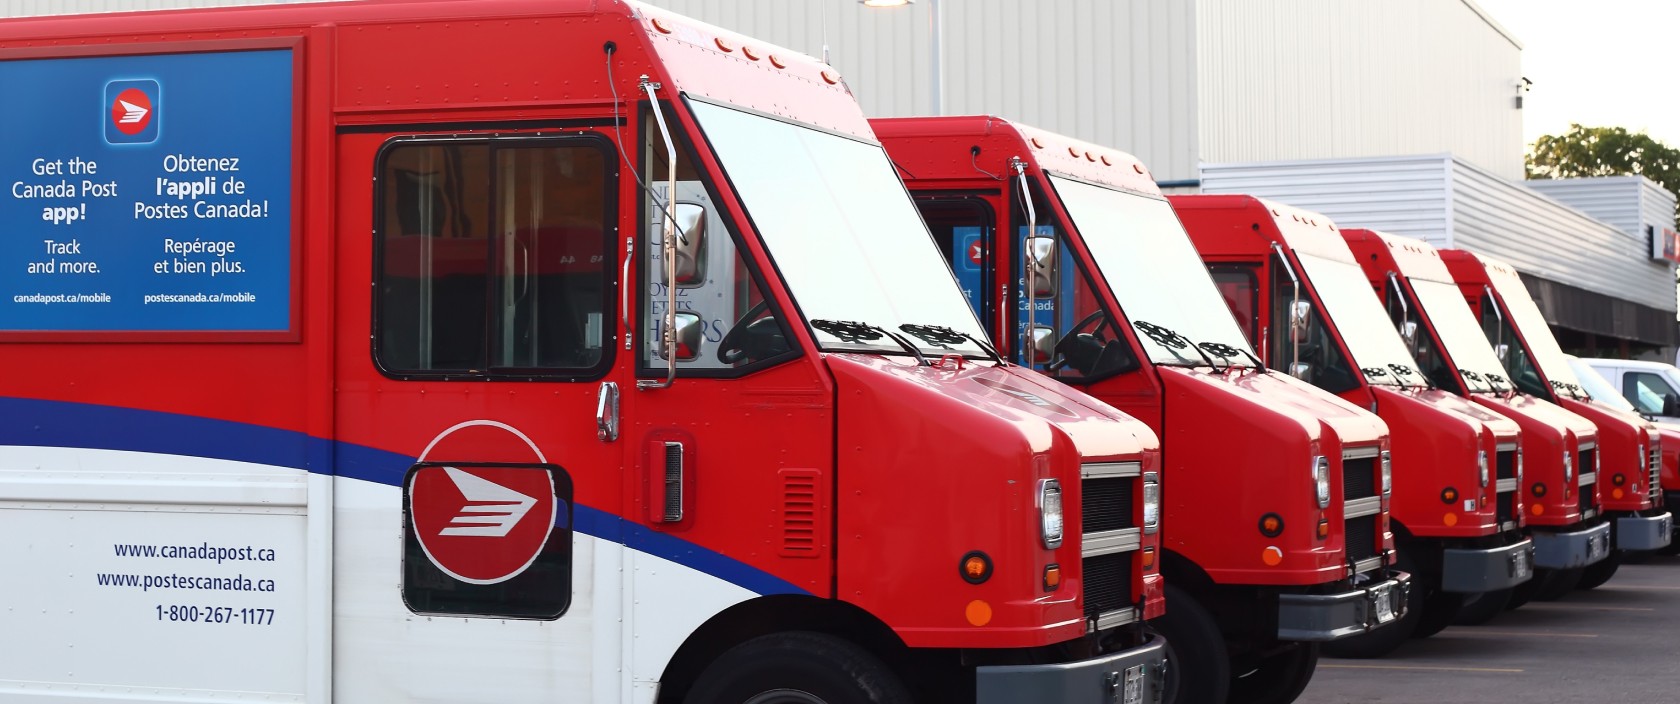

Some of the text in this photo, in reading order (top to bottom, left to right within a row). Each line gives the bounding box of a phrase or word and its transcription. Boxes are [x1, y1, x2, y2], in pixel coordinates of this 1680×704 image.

[33, 157, 97, 175] Get the
[163, 154, 239, 172] Obtenez
[12, 180, 117, 198] Canada Post
[156, 176, 245, 199] l'appli de
[42, 203, 86, 225] app!
[134, 200, 268, 219] Postes Canada!
[44, 239, 80, 254] Track
[164, 238, 235, 256] Repérage
[27, 259, 100, 274] and more.
[153, 258, 246, 276] et bien plus.
[13, 292, 111, 304] canadapost.ca/mobile
[144, 292, 256, 304] postescanada.ca/mobile
[114, 542, 275, 564] www.canadapost.ca
[97, 573, 275, 592] www.postescanada.ca
[156, 605, 275, 625] 1-800-267-1177
